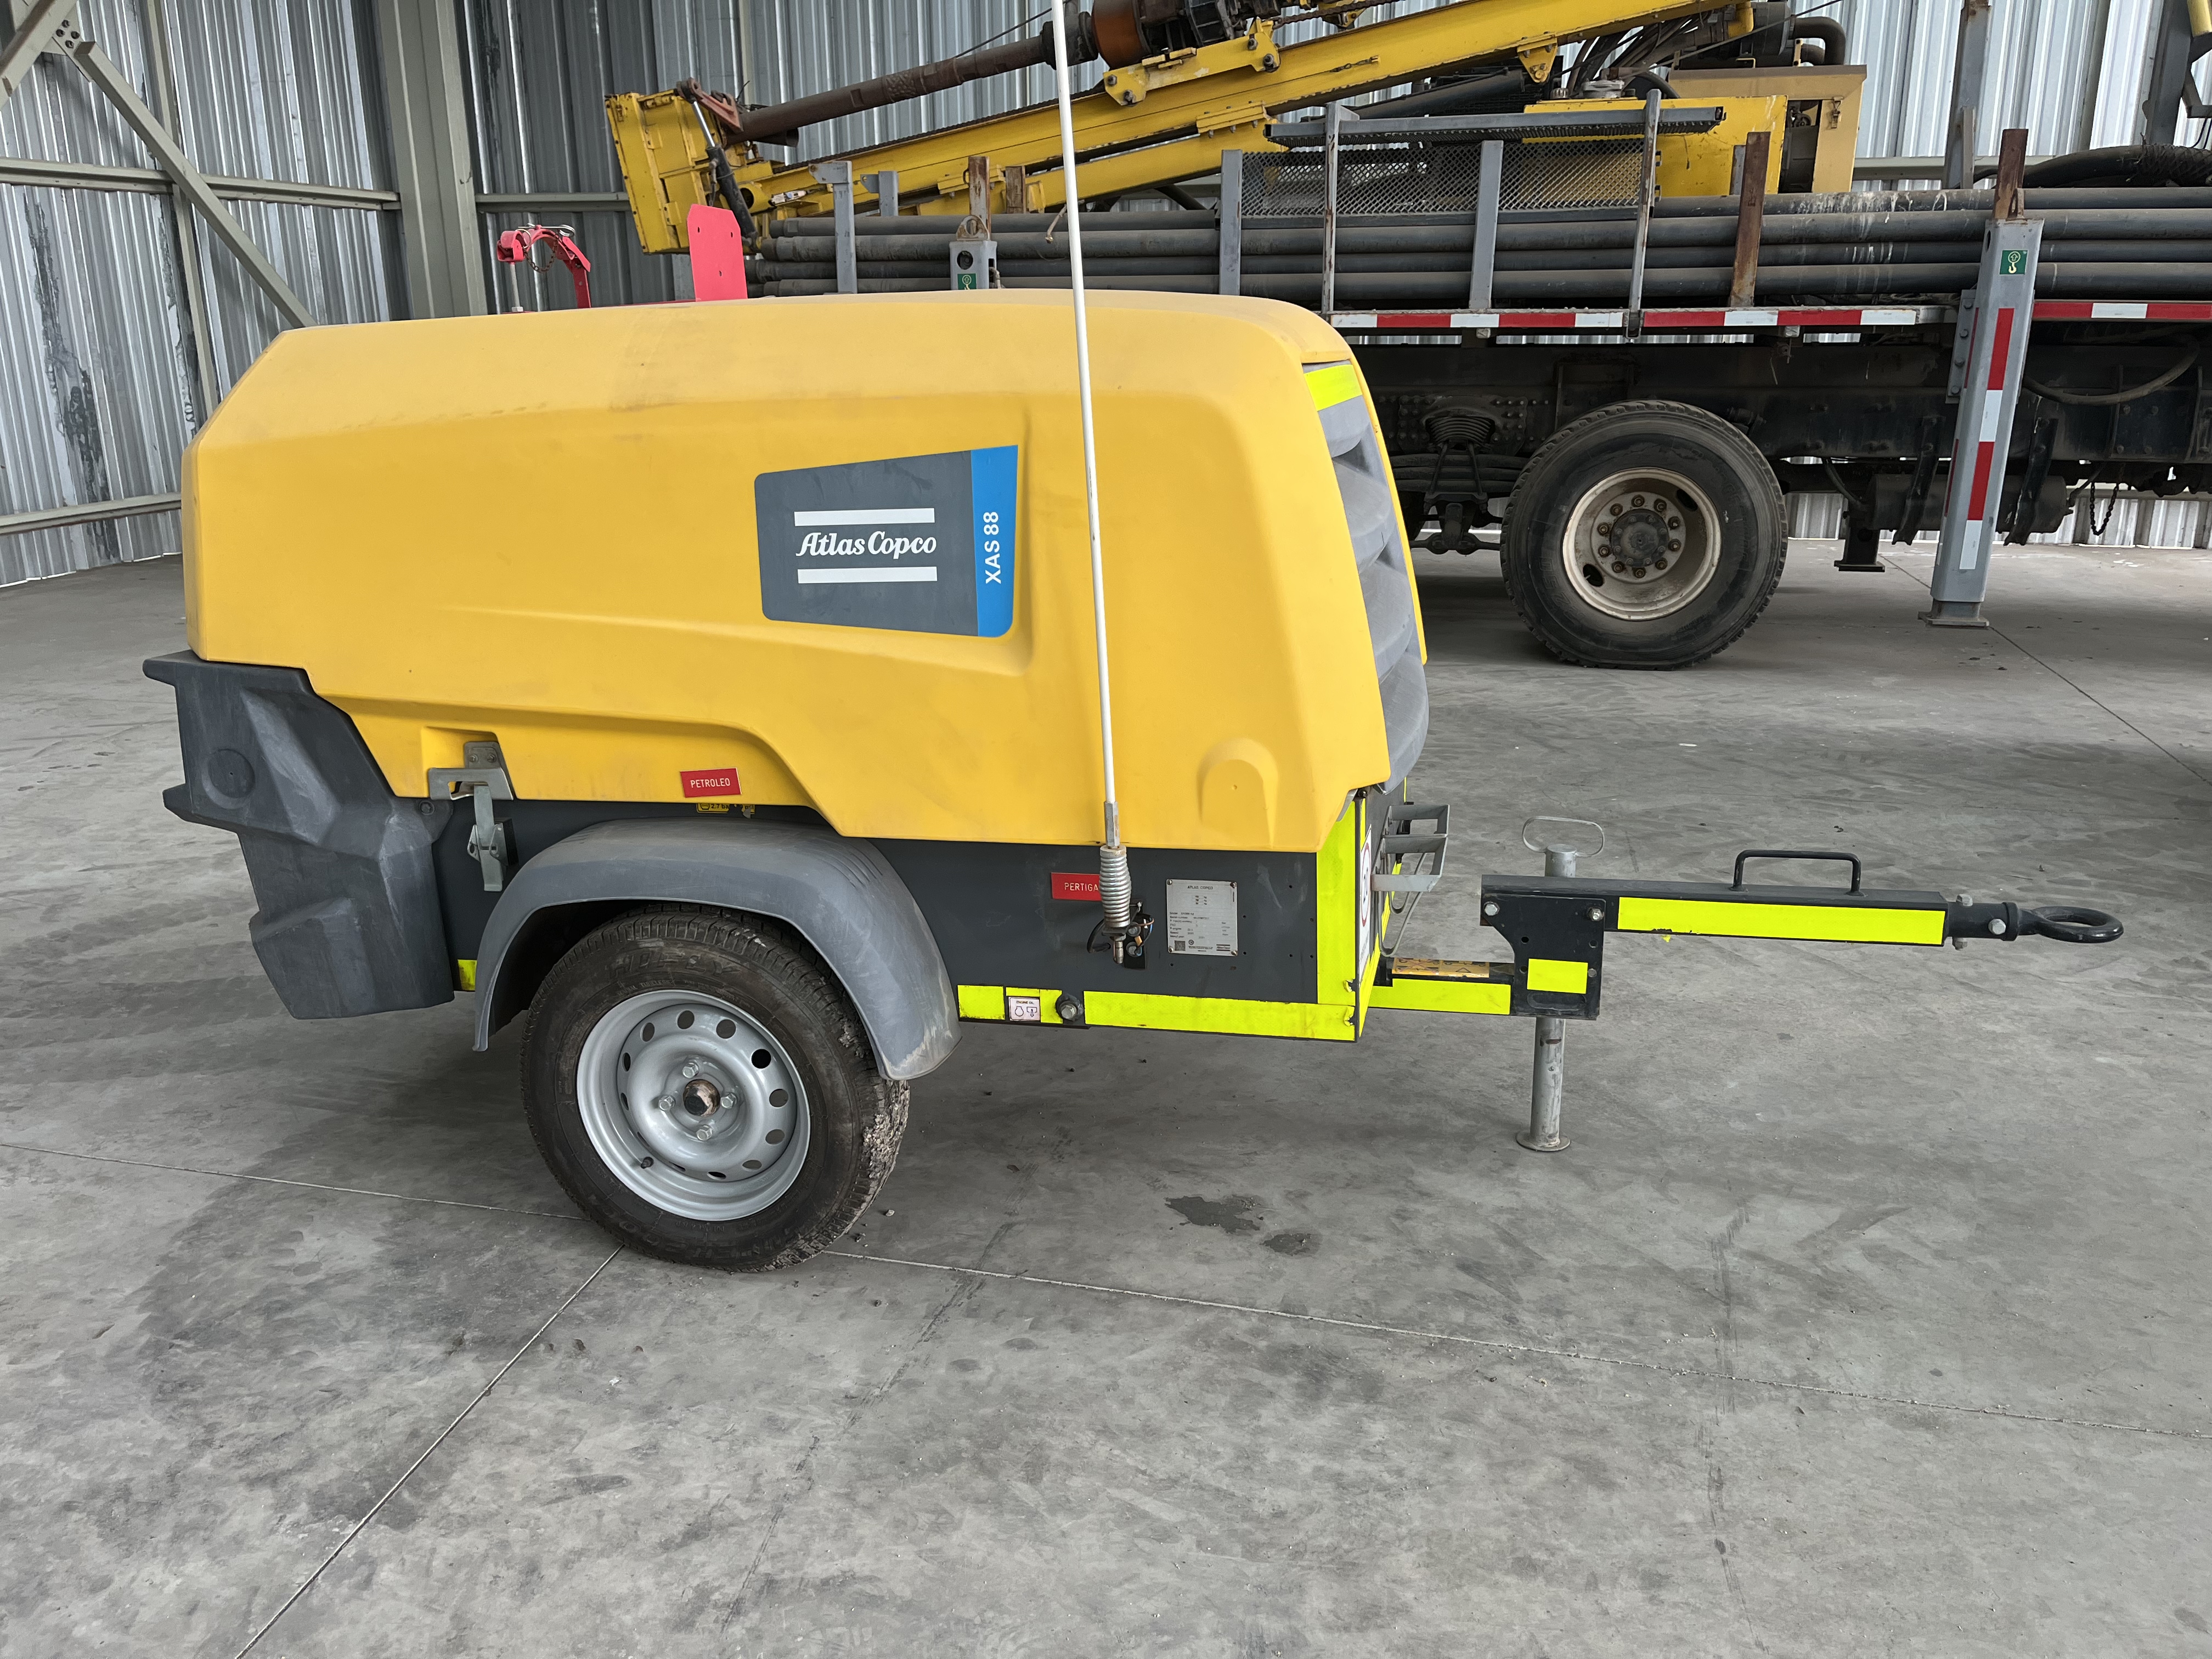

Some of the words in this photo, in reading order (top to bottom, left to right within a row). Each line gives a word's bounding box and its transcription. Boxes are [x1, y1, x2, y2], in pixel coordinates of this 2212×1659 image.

[983, 511, 1000, 536] 88
[795, 532, 865, 557] Atlas
[868, 531, 937, 560] Copco
[984, 540, 1001, 584] XAS
[690, 777, 730, 788] PETROLEO
[1064, 882, 1099, 891] PERTIGA
